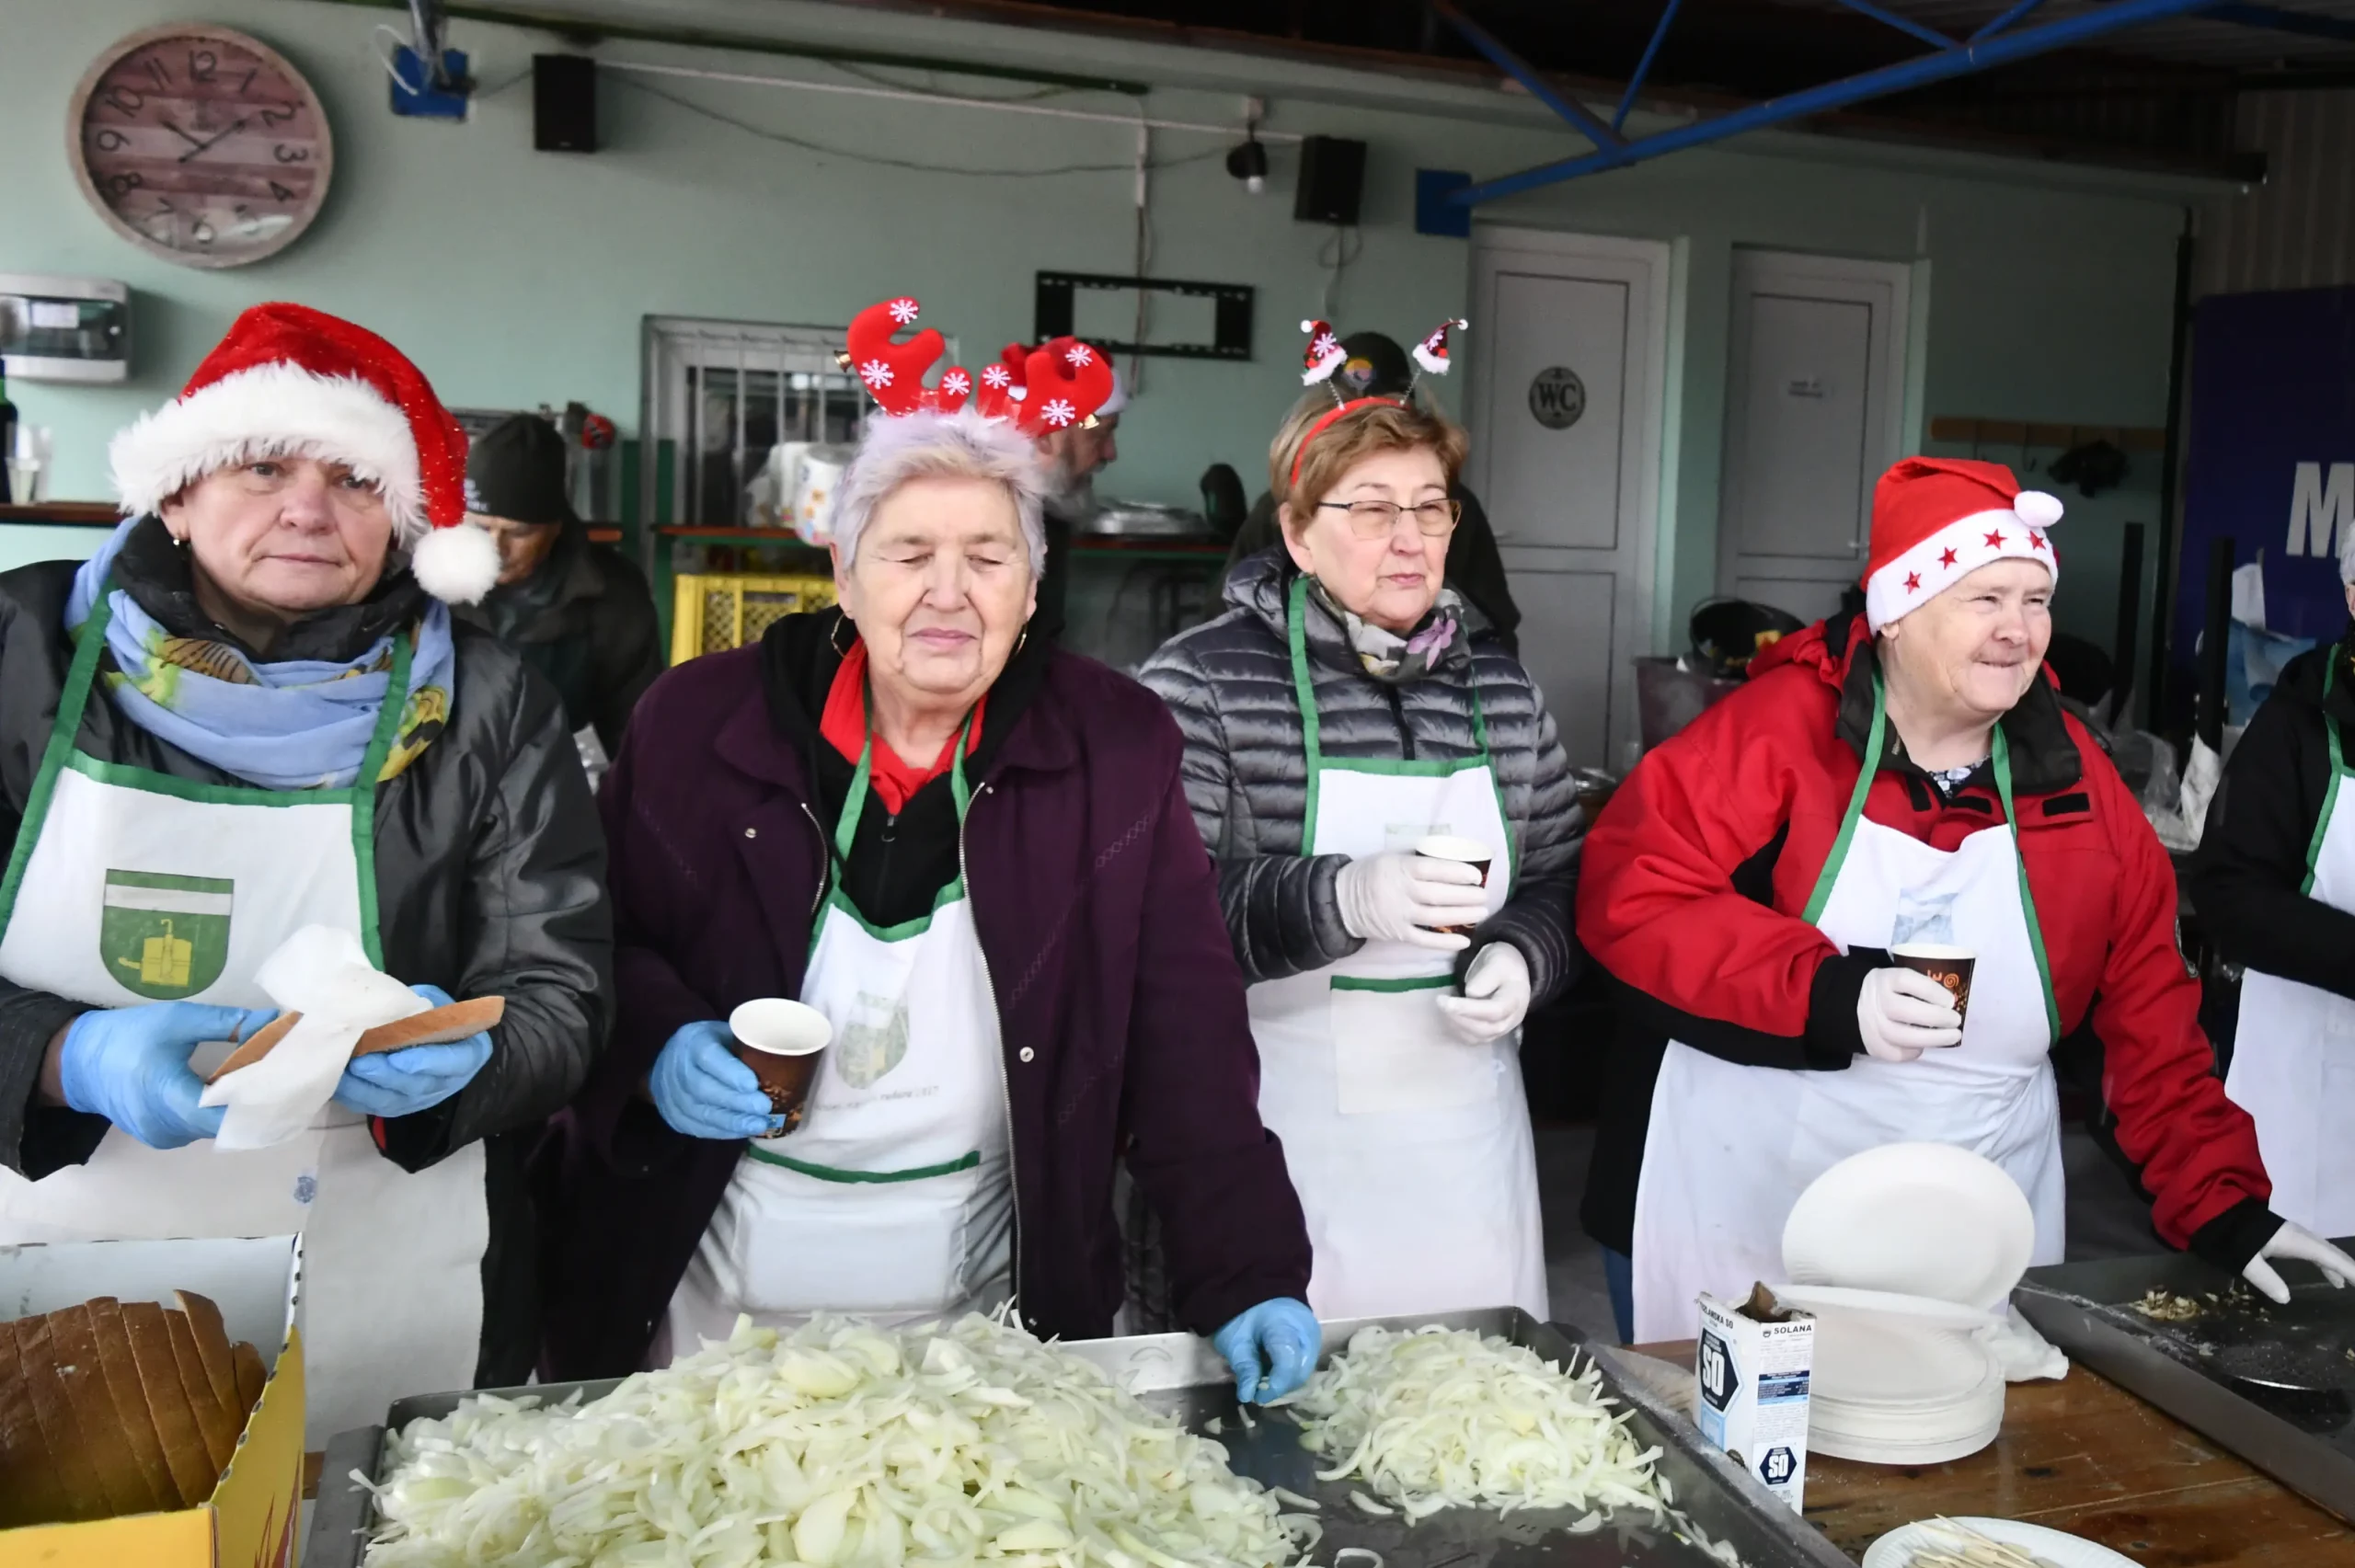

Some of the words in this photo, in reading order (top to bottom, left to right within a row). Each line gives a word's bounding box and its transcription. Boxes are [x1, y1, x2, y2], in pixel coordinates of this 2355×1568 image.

[189, 50, 217, 83] 12
[105, 85, 144, 119] 10
[261, 99, 297, 128] 2
[97, 129, 132, 152] 9
[273, 143, 309, 163] 3
[110, 171, 144, 195] 8
[269, 180, 294, 201] 4
[1538, 383, 1577, 411] WC
[1774, 1324, 1812, 1334] SOLANA
[1702, 1344, 1725, 1397] SO
[1768, 1454, 1789, 1479] SO
